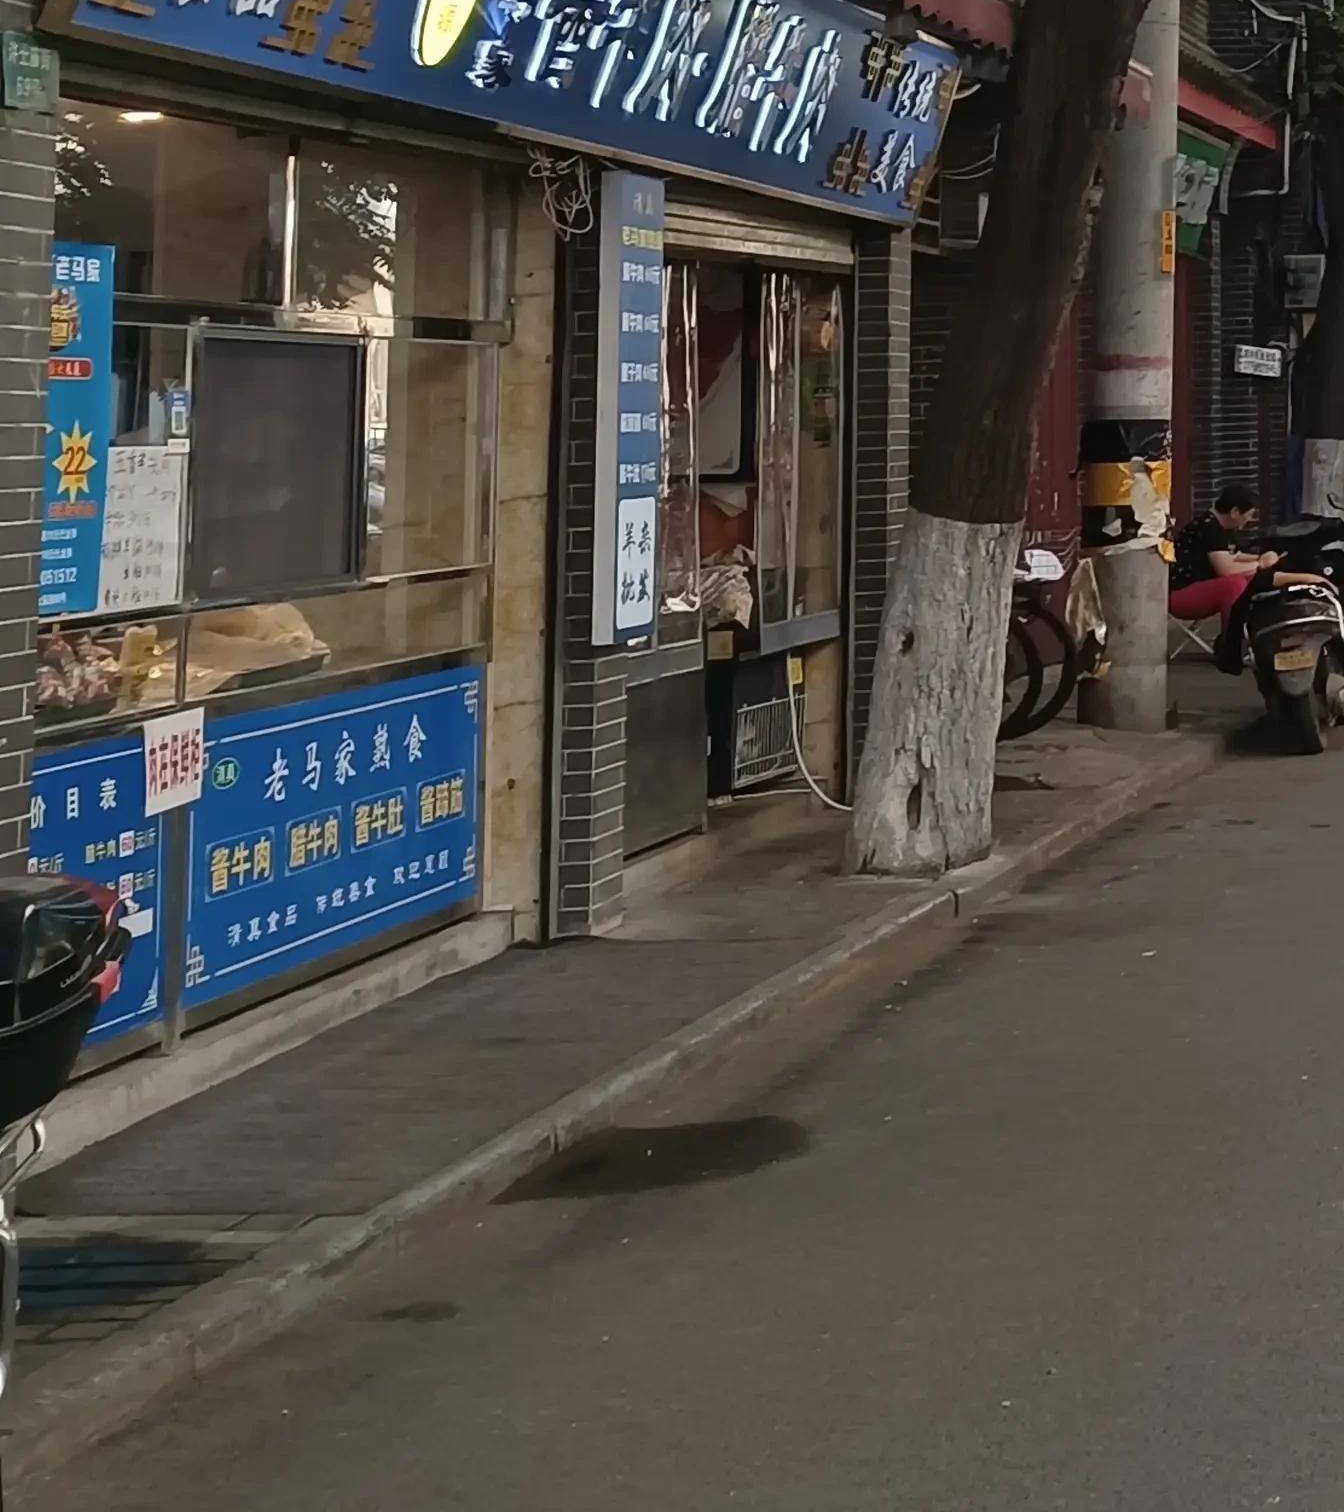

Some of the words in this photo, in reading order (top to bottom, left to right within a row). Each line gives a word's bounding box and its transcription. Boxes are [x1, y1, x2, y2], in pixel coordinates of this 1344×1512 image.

[55, 255, 101, 283] 老马家
[63, 446, 87, 476] 22
[263, 713, 428, 803] 老马家熟食
[30, 777, 118, 830] 价目表
[209, 835, 273, 894] 酱牛肉
[354, 794, 405, 847] 酱牛肚
[227, 903, 299, 948] 清真食品
